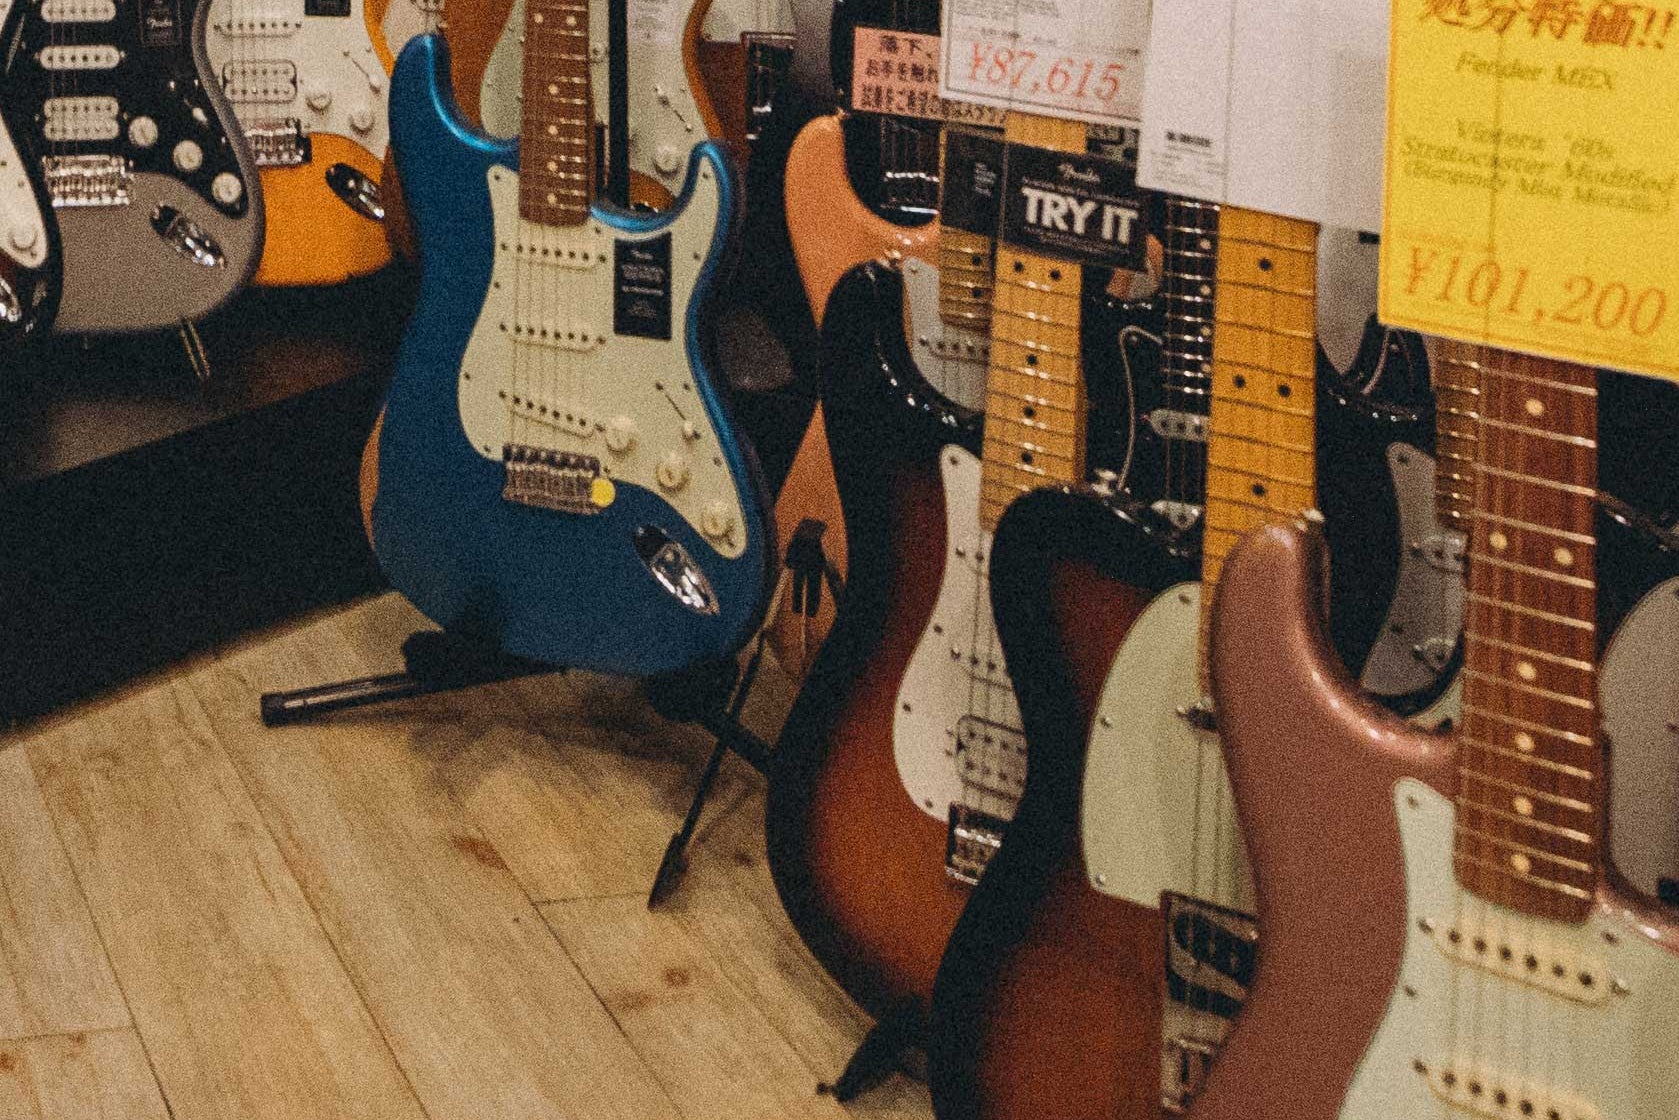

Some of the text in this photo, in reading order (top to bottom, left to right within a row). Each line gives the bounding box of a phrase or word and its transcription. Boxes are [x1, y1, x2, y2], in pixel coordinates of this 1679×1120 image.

[968, 42, 1124, 103] ¥87,615
[1021, 186, 1139, 242] TRY IT
[1404, 245, 1668, 338] ¥101,200
